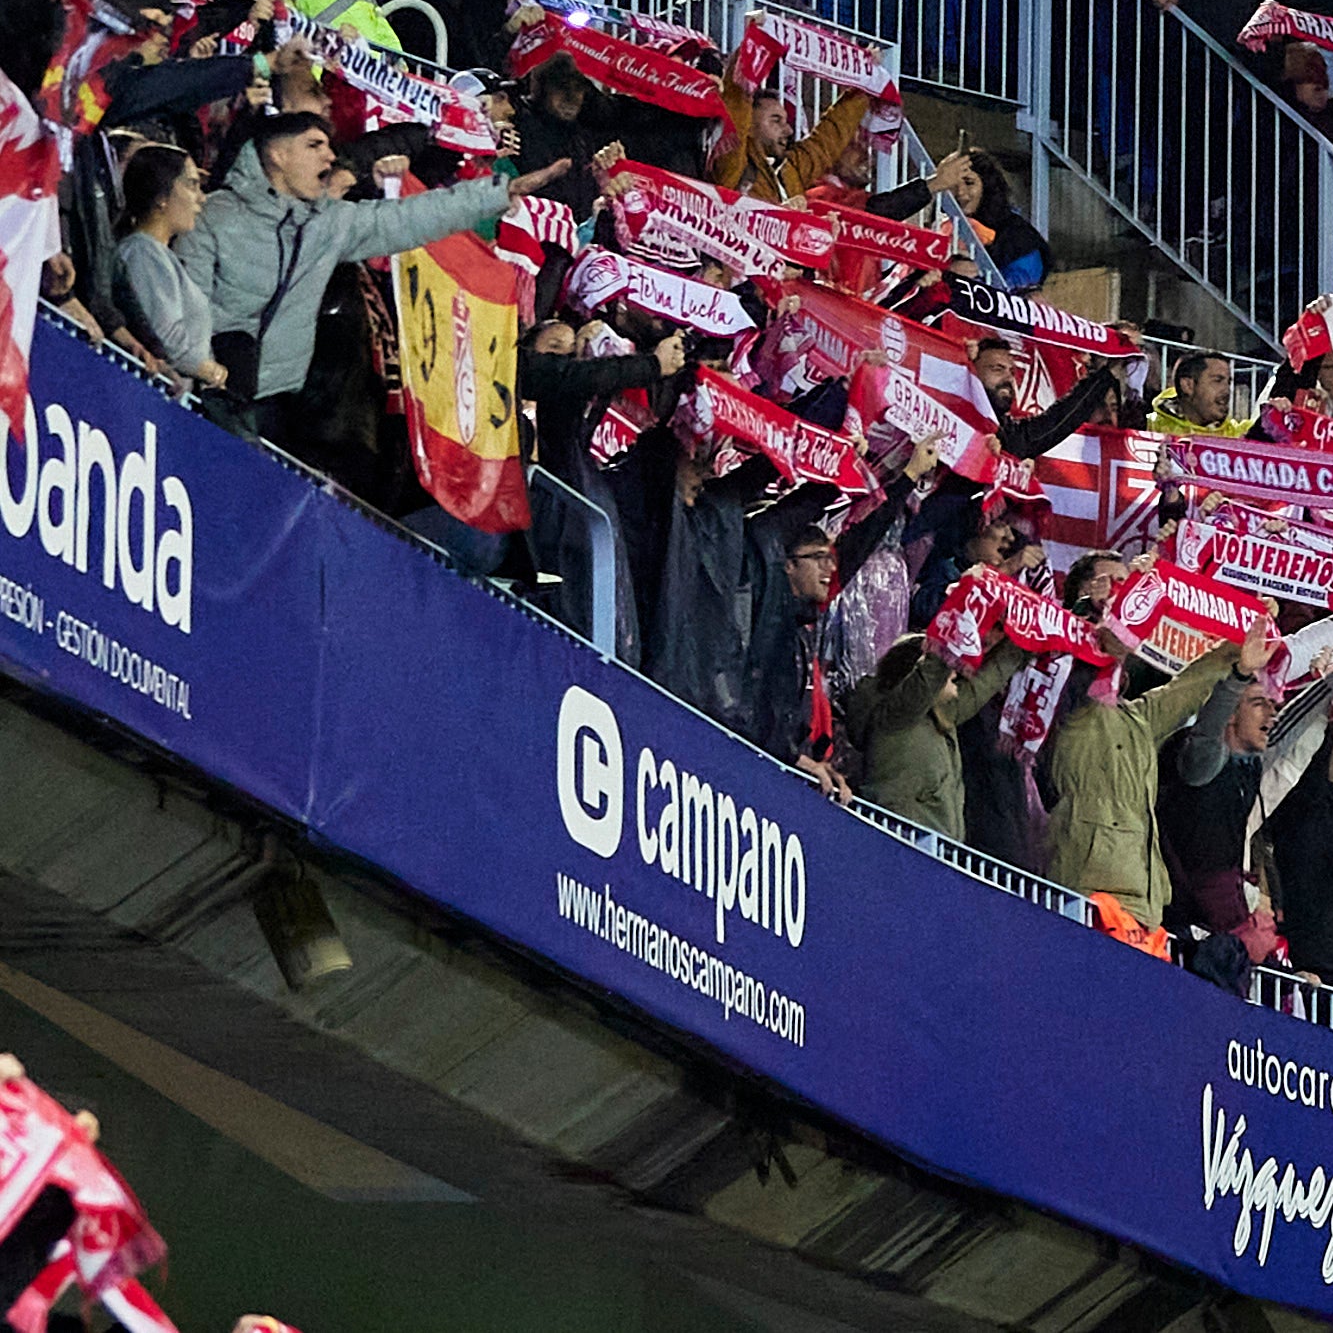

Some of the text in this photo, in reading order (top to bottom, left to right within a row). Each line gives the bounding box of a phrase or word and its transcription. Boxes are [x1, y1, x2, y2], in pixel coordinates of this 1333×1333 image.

[626, 273, 734, 327] Eterna Lucha
[1199, 449, 1311, 492] GRANADA
[1167, 575, 1241, 628] GRANADA
[55, 610, 192, 720] GESTIÓN DOCUMENTAL
[637, 747, 807, 948] campano
[557, 871, 807, 1048] www.hermanoscampano.com
